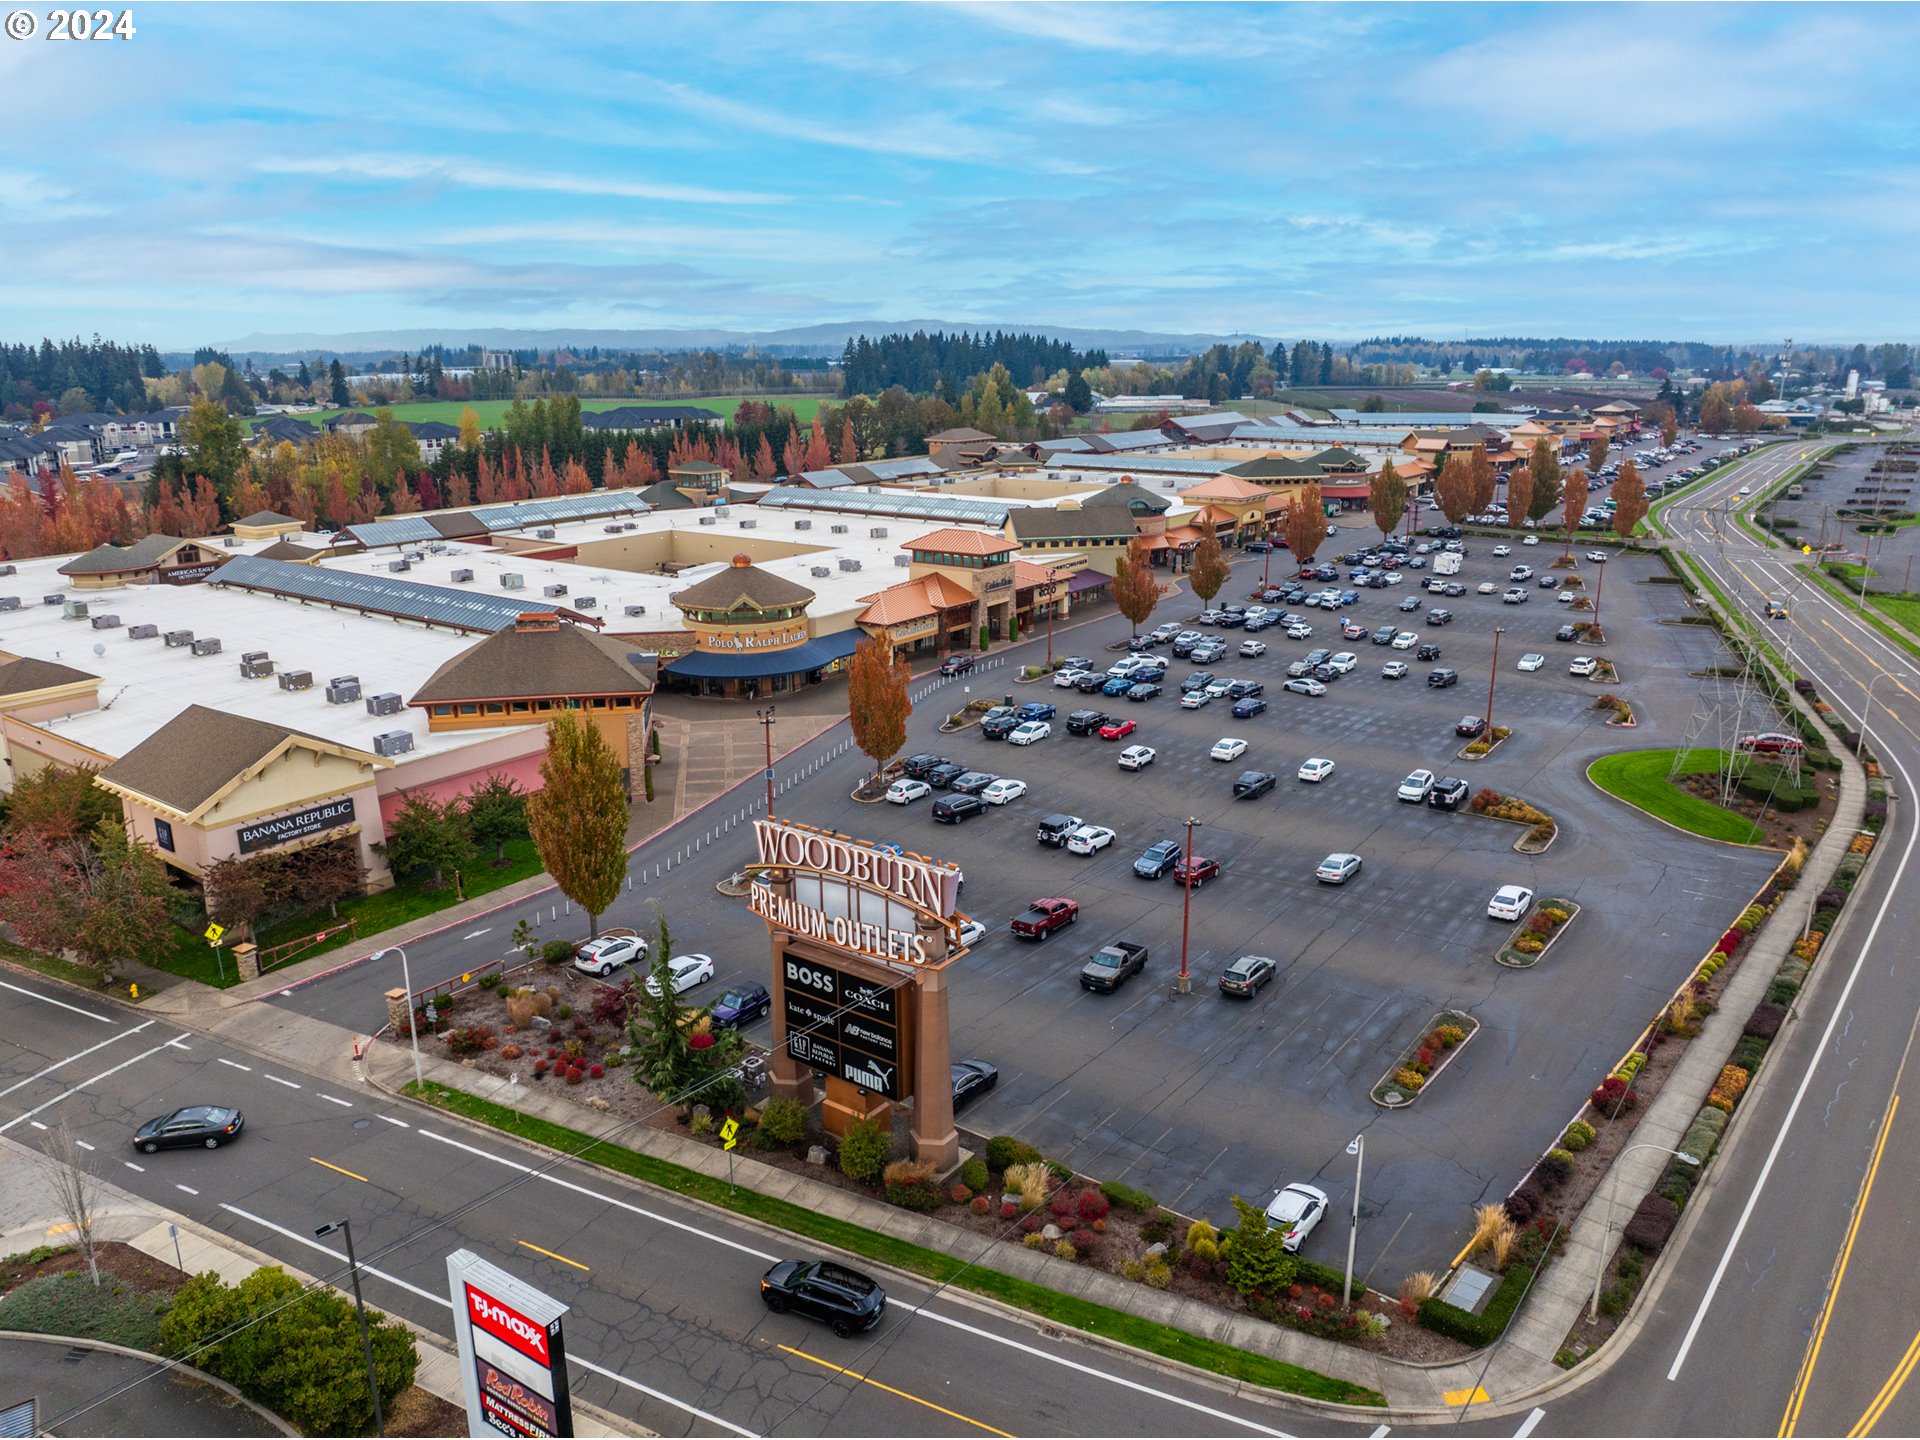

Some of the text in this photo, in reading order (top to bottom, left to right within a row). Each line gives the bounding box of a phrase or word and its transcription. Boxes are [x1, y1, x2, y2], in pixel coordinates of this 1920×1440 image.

[168, 566, 215, 577] AMERICAN EAGLE
[178, 572, 206, 580] OUTFITTERS
[708, 631, 807, 648] POLO RALPH LAUREN
[243, 802, 351, 842] BANANA REPUBLIC
[277, 822, 322, 840] FACTORY STORE
[752, 820, 945, 917] WOODBURN
[751, 883, 828, 941] PREMIUM
[787, 962, 834, 993] BOSS
[844, 989, 890, 1011] COACH
[789, 1001, 835, 1026] kate spade
[812, 1043, 834, 1055] BANANA
[870, 1032, 893, 1046] balance
[811, 1054, 836, 1067] FACTORY
[812, 1048, 836, 1062] REPUBLIC
[845, 1063, 883, 1092] PUMA
[486, 1368, 512, 1396] Red
[511, 1384, 549, 1422] Robin
[488, 1411, 516, 1438] See's
